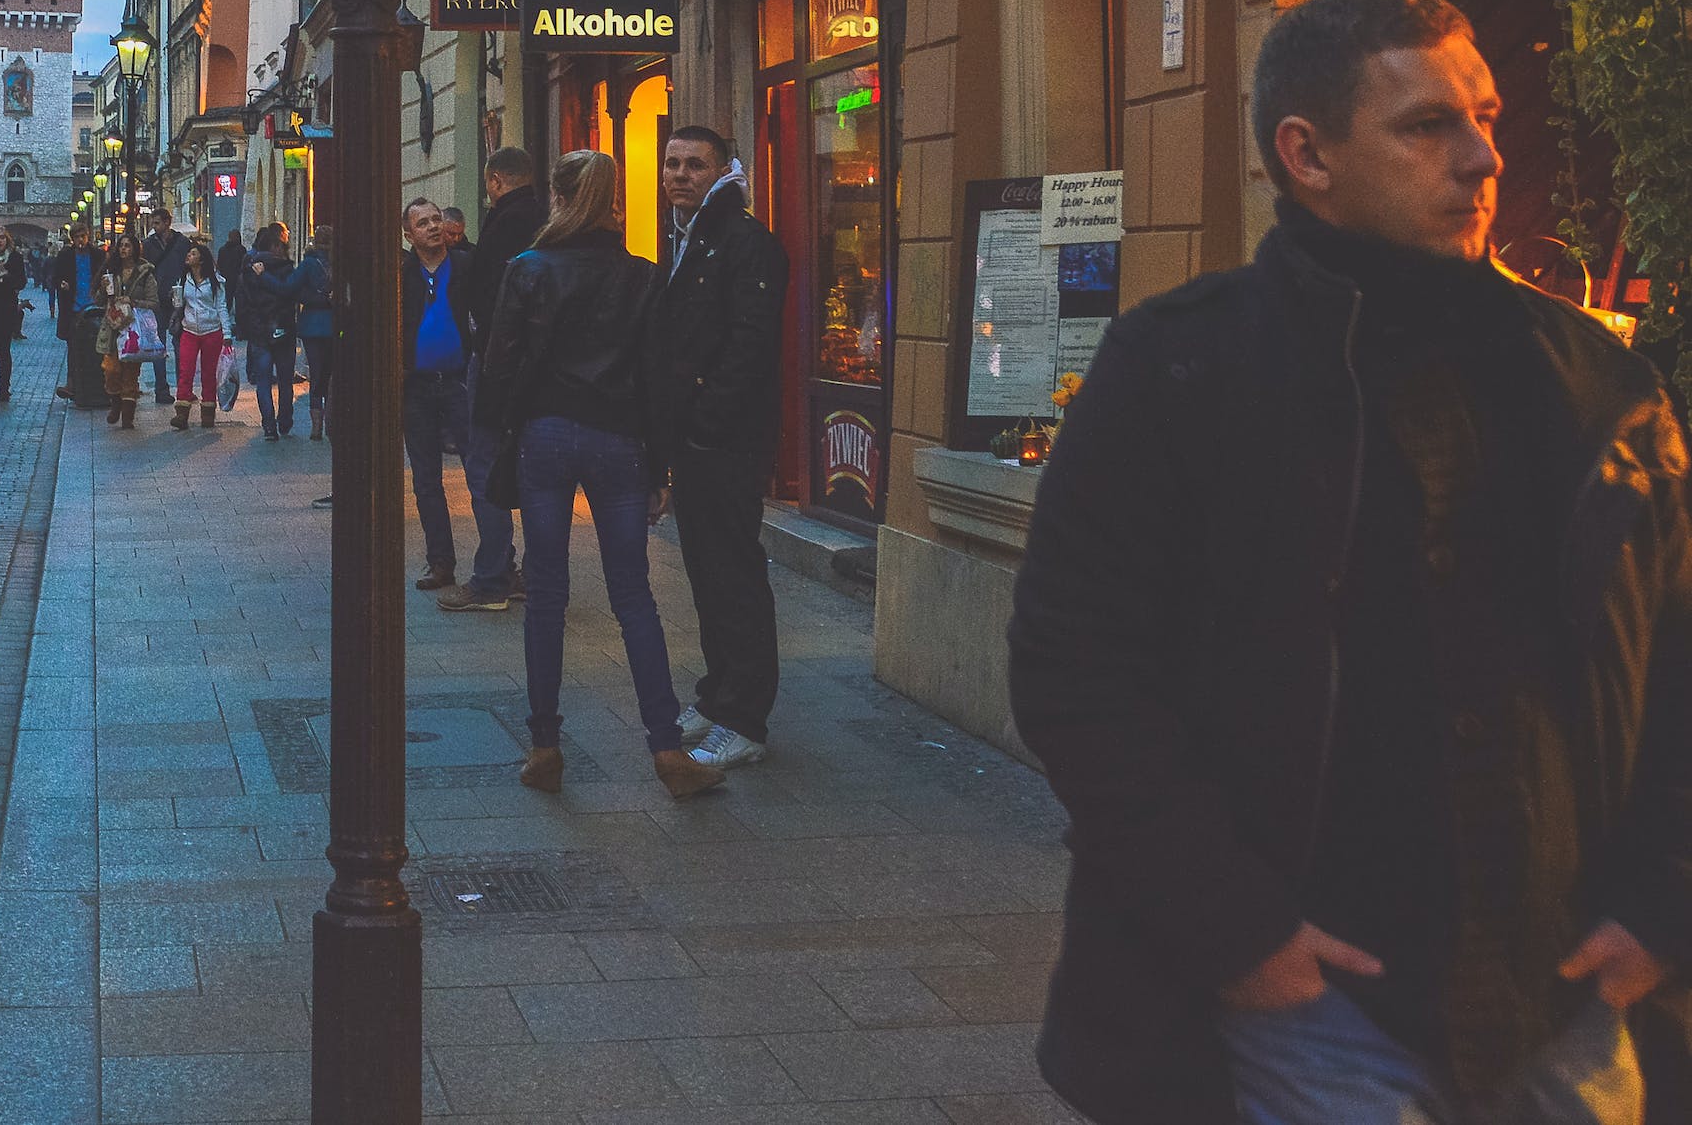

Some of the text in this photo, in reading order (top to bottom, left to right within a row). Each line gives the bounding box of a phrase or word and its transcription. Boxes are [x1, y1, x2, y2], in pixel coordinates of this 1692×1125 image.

[533, 8, 675, 38] Alkohole
[1051, 179, 1089, 194] Happy
[1053, 216, 1068, 228] 20
[827, 419, 873, 477] ŻYWIEC
